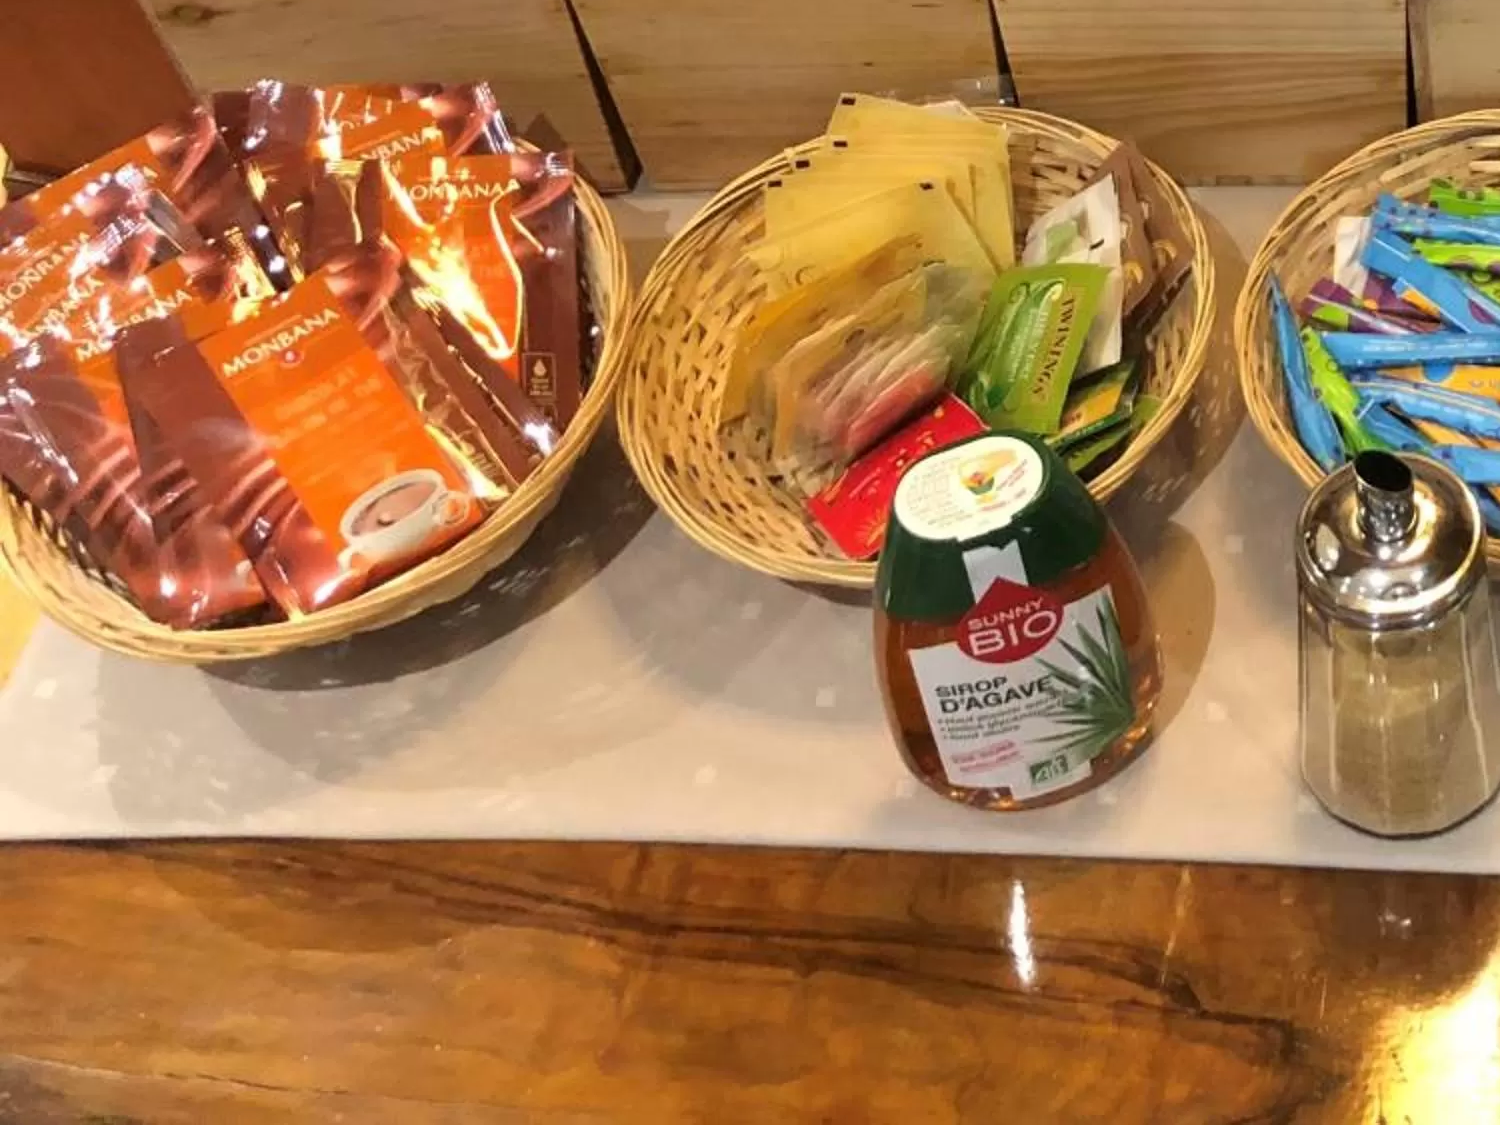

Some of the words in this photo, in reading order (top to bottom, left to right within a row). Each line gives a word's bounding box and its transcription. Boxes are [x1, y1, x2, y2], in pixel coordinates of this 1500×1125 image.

[222, 307, 341, 378] MONBANA
[967, 596, 1044, 631] SUNNY
[968, 610, 1057, 656] BIO
[935, 675, 1008, 698] SIROP
[940, 674, 1051, 714] D'AGAVE
